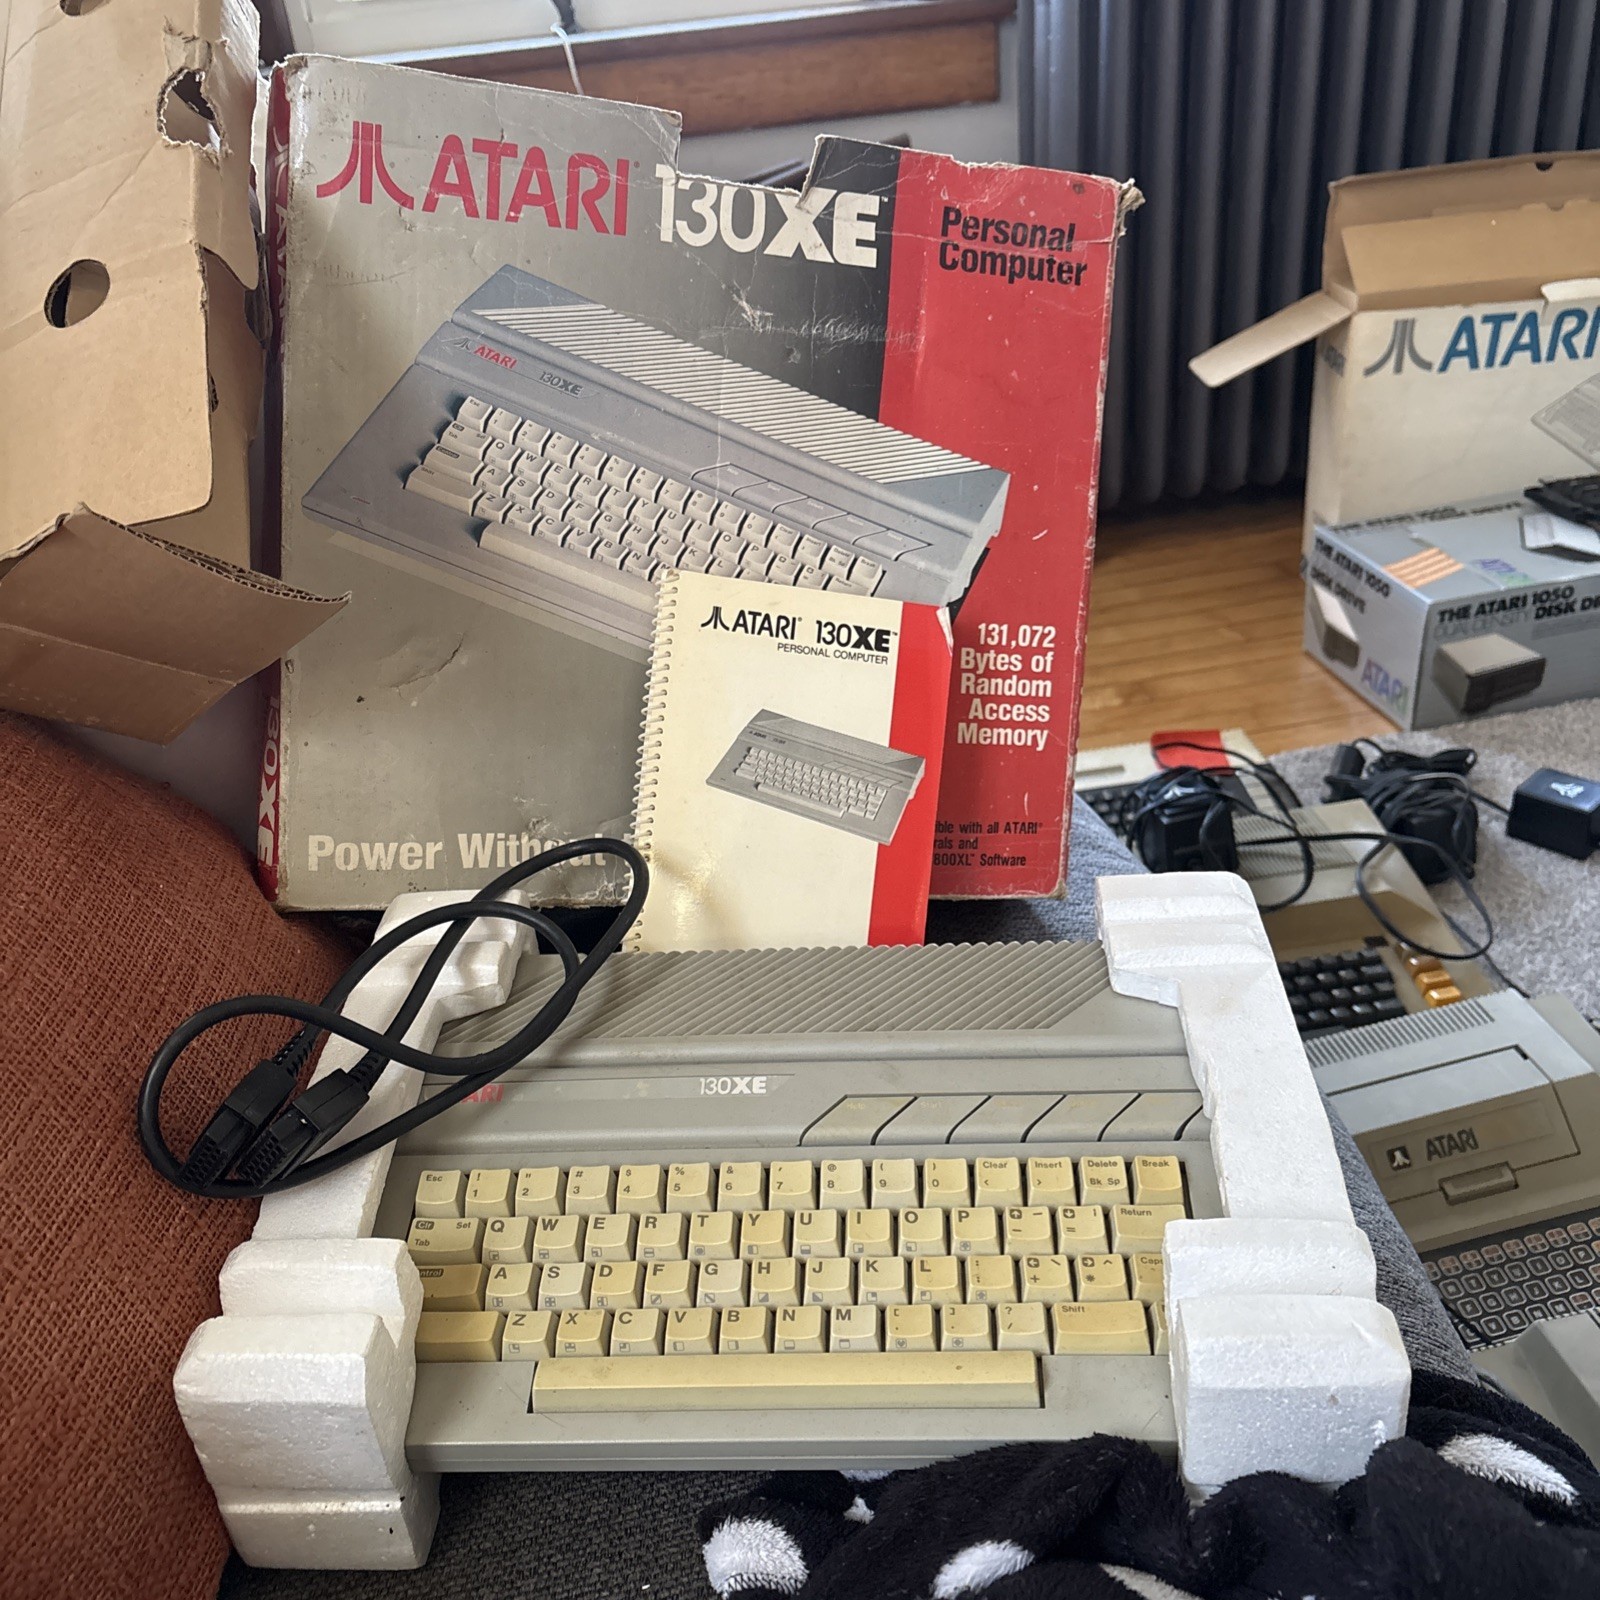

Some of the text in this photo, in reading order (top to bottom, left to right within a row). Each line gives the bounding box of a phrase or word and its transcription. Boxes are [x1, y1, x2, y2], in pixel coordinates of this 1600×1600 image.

[421, 134, 882, 268] ATARI 130XE
[941, 206, 1075, 253] Personal
[939, 241, 1088, 286] Computer
[1438, 306, 1600, 374] ATARI
[473, 344, 584, 396] ATARI 130XE
[496, 442, 505, 450] Q
[525, 453, 537, 462] W
[553, 465, 563, 474] E
[583, 478, 592, 486] R
[641, 500, 649, 508] Y
[668, 512, 677, 520] U
[723, 535, 732, 543] O
[487, 468, 496, 476] A
[604, 515, 613, 523] G
[632, 526, 642, 534] H
[688, 549, 698, 557] K
[717, 560, 723, 568] L
[1438, 585, 1575, 622] THE ATARI 1050
[1534, 600, 1577, 619] DISK
[732, 609, 891, 653] ATARI 130XE
[978, 623, 1056, 649] 131,072
[777, 642, 889, 665] PERSONAL COMPUTER
[960, 647, 1054, 675] Bytes of
[960, 673, 1052, 698] Random
[1362, 658, 1409, 714] ATARI
[969, 699, 1050, 723] Access
[957, 722, 1049, 751] Memory
[959, 821, 982, 834] with
[987, 821, 999, 834] all
[1003, 821, 1038, 834] ATARI
[958, 837, 978, 850] and
[307, 834, 443, 873] Power
[980, 853, 1027, 867] Software
[700, 1076, 768, 1096] 130XE
[1425, 1128, 1480, 1162] ATARI
[726, 1166, 734, 1174] &
[827, 1164, 837, 1172] @
[982, 1161, 1008, 1169] Clear
[1034, 1161, 1063, 1169] Insert
[1087, 1160, 1118, 1168] Delete
[1142, 1159, 1170, 1168] Break
[426, 1174, 443, 1182] Esc
[674, 1167, 685, 1176] %
[623, 1185, 631, 1193] 4
[674, 1183, 681, 1191] 5
[725, 1182, 733, 1191] 6
[776, 1181, 783, 1190] 7
[827, 1180, 835, 1188] 8
[879, 1179, 887, 1188] 9
[1107, 1178, 1121, 1187] Sp
[472, 1189, 478, 1197] 1
[522, 1188, 530, 1197] 2
[573, 1186, 580, 1195] 3
[748, 1213, 761, 1226] Y
[800, 1213, 812, 1226] U
[856, 1212, 861, 1224] I
[904, 1211, 919, 1224] O
[958, 1210, 970, 1223] P
[1120, 1209, 1152, 1217] Return
[490, 1219, 505, 1233] Q
[541, 1218, 559, 1231] W
[593, 1217, 606, 1230] E
[644, 1216, 658, 1229] R
[697, 1215, 709, 1227] T
[414, 1239, 430, 1247] Tab
[547, 1266, 560, 1279] S
[599, 1265, 613, 1278] D
[653, 1263, 665, 1276] F
[704, 1263, 719, 1276] G
[758, 1262, 771, 1274] H
[812, 1261, 823, 1274] J
[865, 1260, 879, 1272] K
[920, 1260, 932, 1272] L
[494, 1267, 508, 1279] A
[782, 1309, 796, 1321] N
[836, 1308, 852, 1321] M
[1005, 1307, 1012, 1315] ?
[1062, 1305, 1085, 1313] Shift
[512, 1314, 526, 1326] Z
[565, 1313, 578, 1325] X
[619, 1311, 633, 1324] C
[674, 1311, 687, 1323] V
[728, 1310, 740, 1322] B
